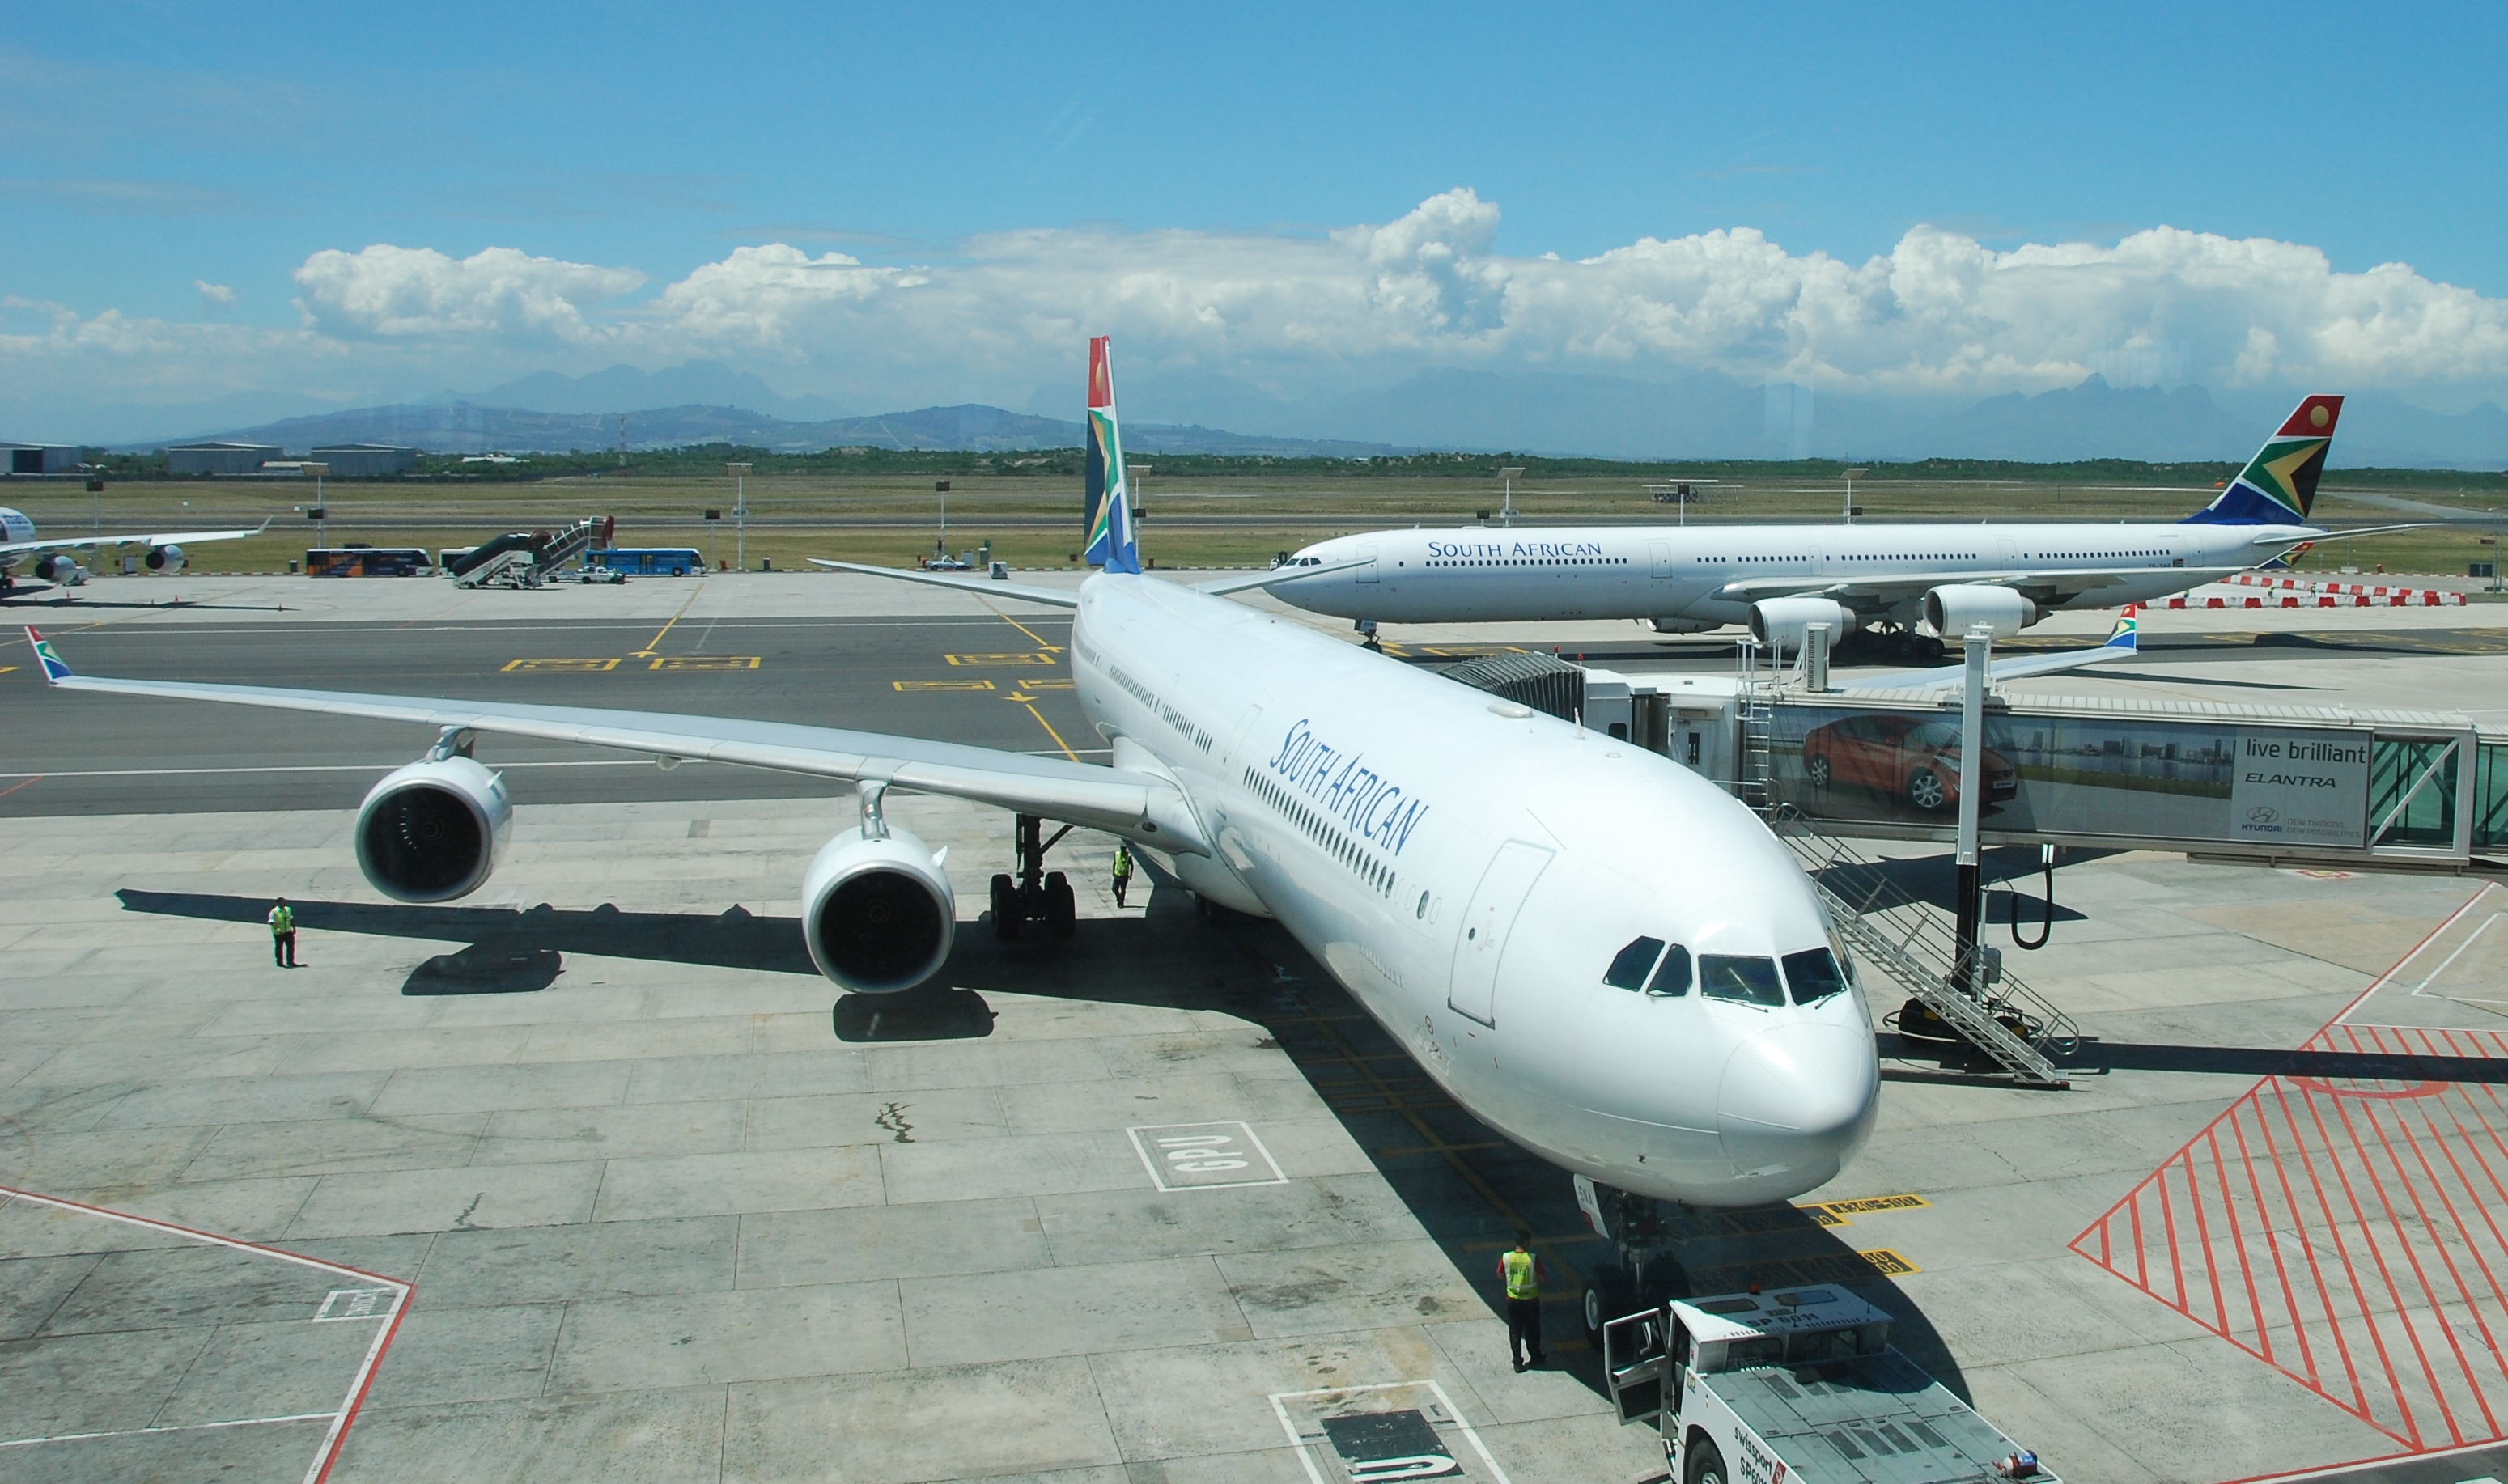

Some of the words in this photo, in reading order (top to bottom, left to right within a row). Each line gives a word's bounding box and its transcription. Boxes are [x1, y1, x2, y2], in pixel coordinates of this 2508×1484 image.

[1428, 541, 1502, 558] SOUTH
[1512, 541, 1602, 558] AFRICAN
[2247, 738, 2281, 758] live
[2289, 741, 2366, 764] brilliant
[1270, 719, 1342, 798] SOUTH
[1320, 752, 1429, 856] AFRICAN
[2245, 773, 2336, 788] ELANTRA
[2242, 823, 2282, 833] HYUNDAI
[1157, 1135, 1249, 1172] GPU
[1734, 1427, 1772, 1477] swissport
